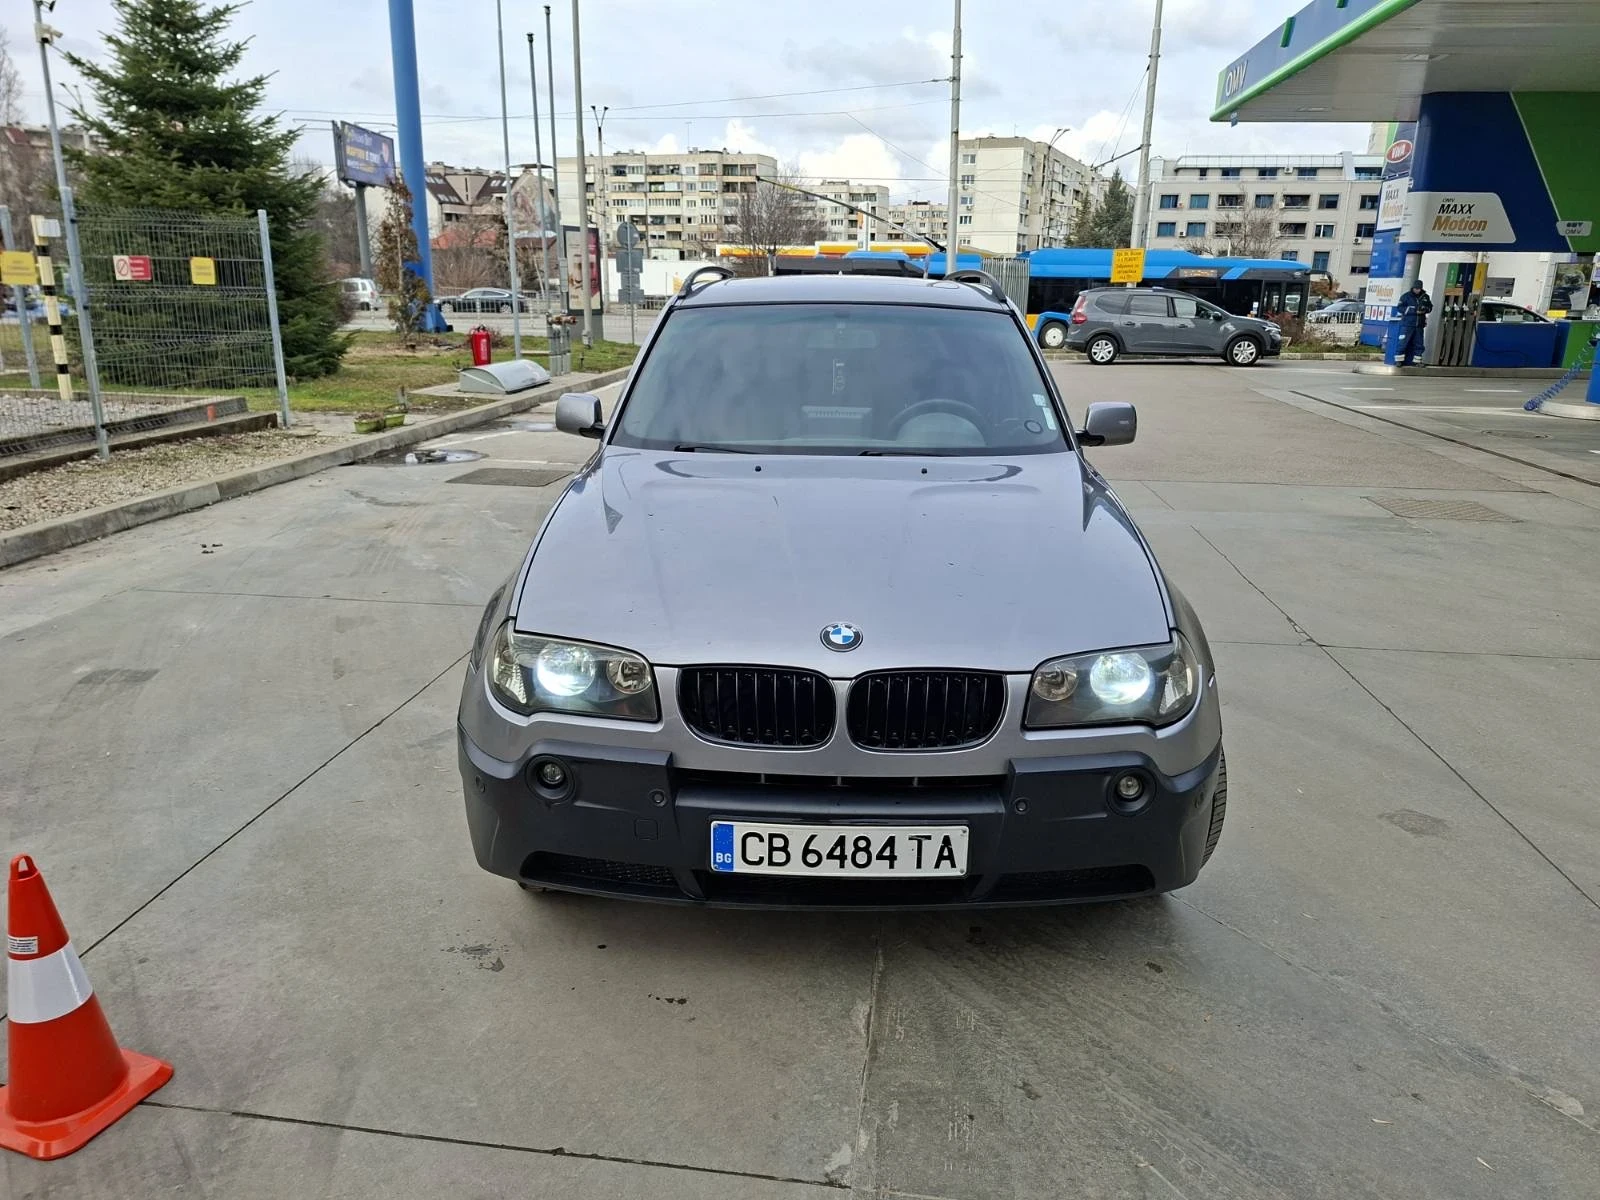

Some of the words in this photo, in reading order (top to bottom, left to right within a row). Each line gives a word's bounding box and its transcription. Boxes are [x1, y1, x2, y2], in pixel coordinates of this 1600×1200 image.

[1226, 61, 1248, 96] OMV
[1438, 203, 1475, 215] MAXX
[1432, 215, 1488, 232] Motion
[715, 853, 732, 864] BG
[741, 832, 791, 867] CB
[801, 834, 898, 869] 6484
[908, 834, 957, 869] TA
